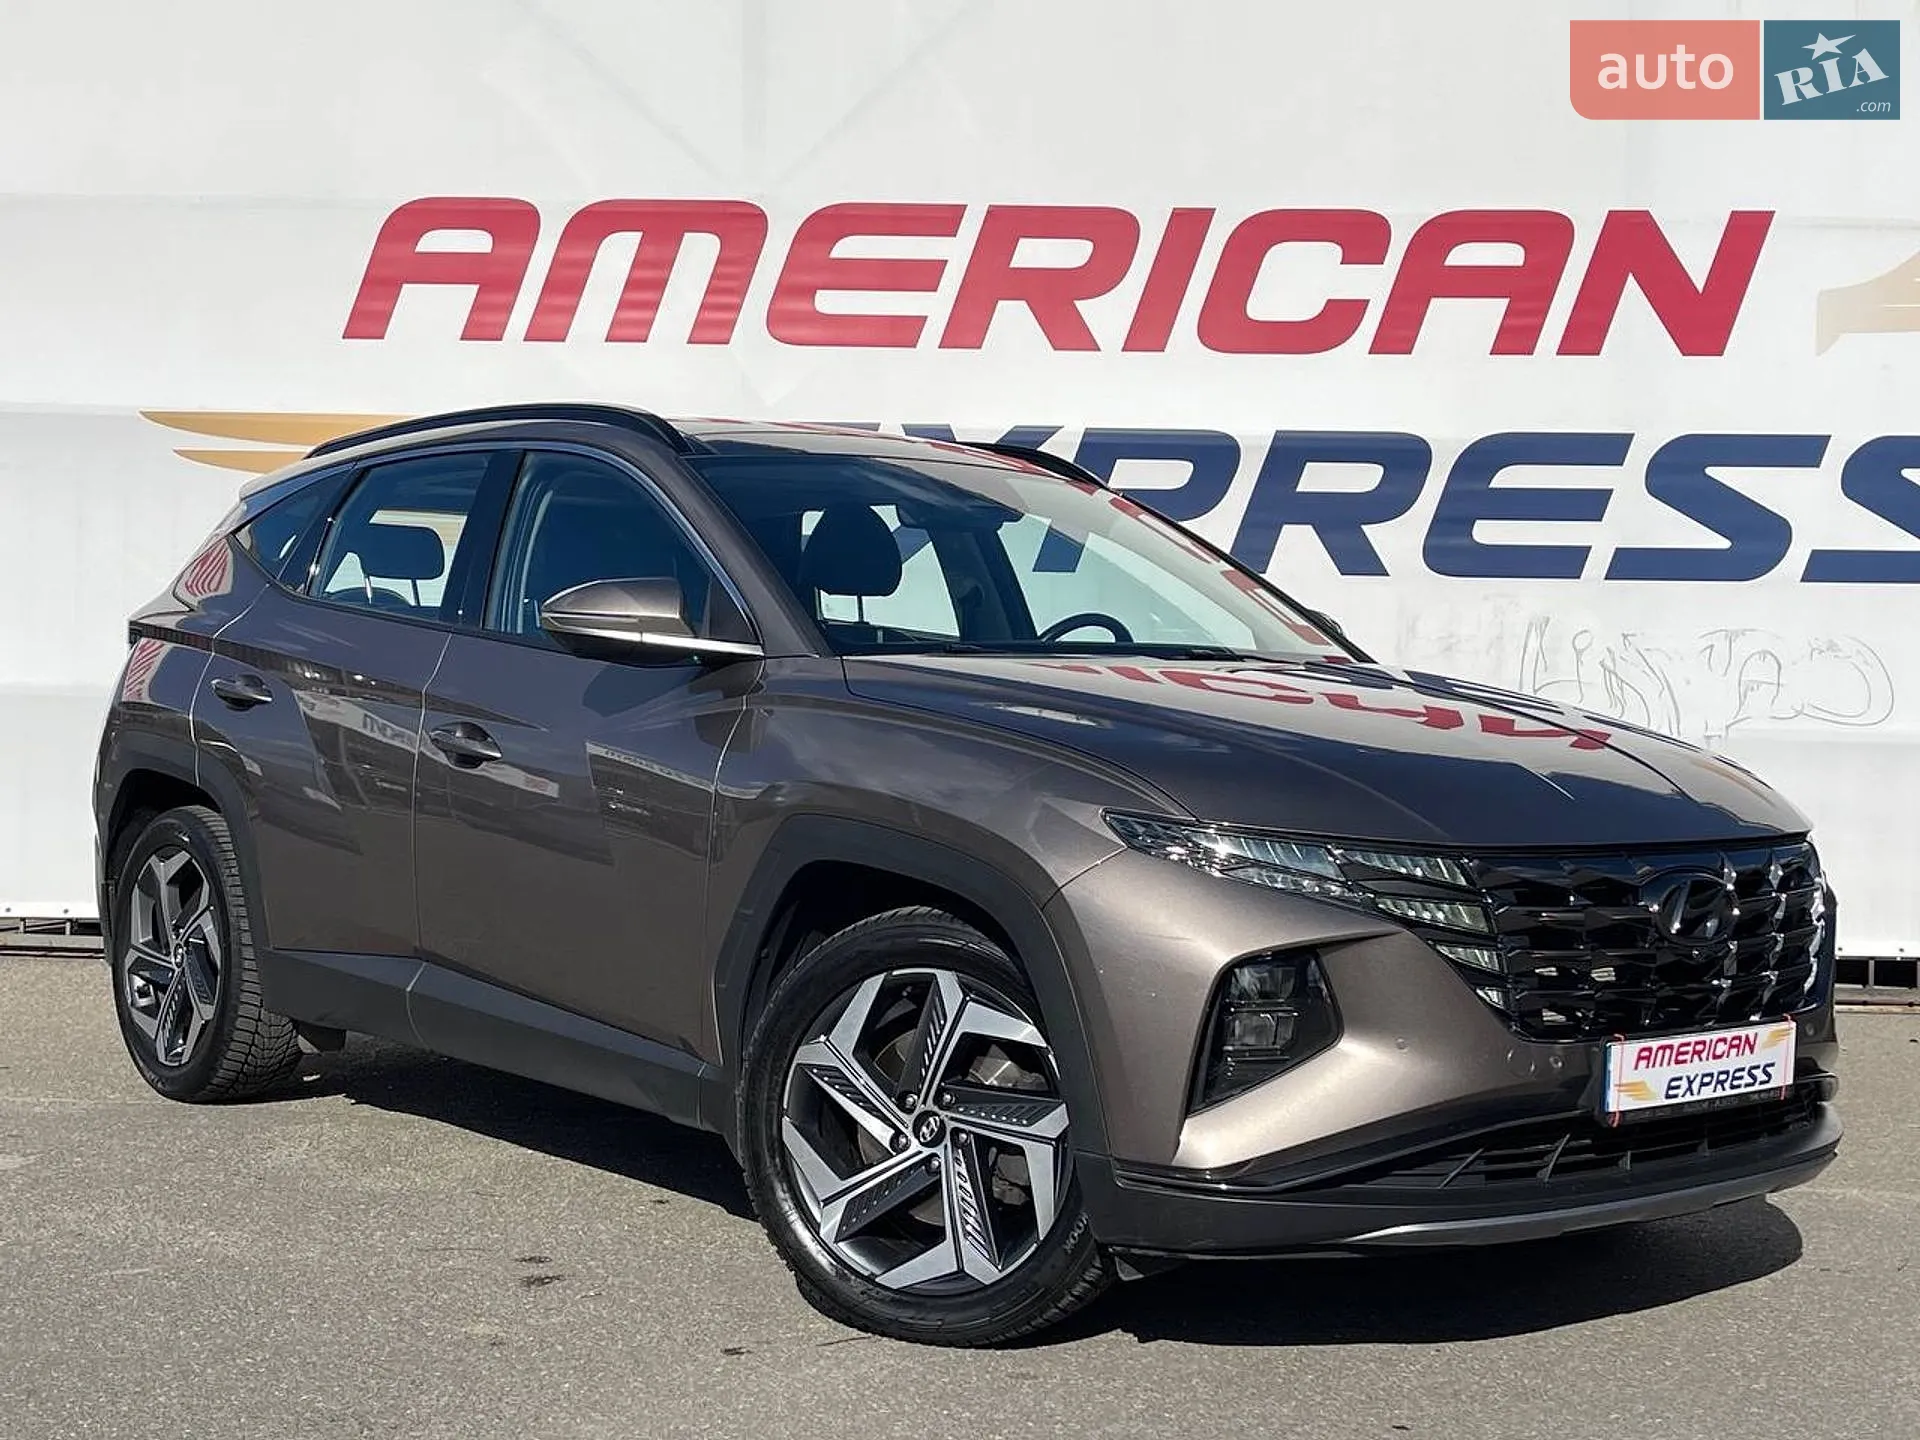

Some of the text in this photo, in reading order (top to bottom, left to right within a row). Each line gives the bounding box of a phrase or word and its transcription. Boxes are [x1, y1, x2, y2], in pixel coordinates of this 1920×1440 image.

[342, 196, 1775, 356] AMERICAN
[1635, 1033, 1758, 1069] AMERICAN
[1666, 1063, 1775, 1098] EXPRESS
